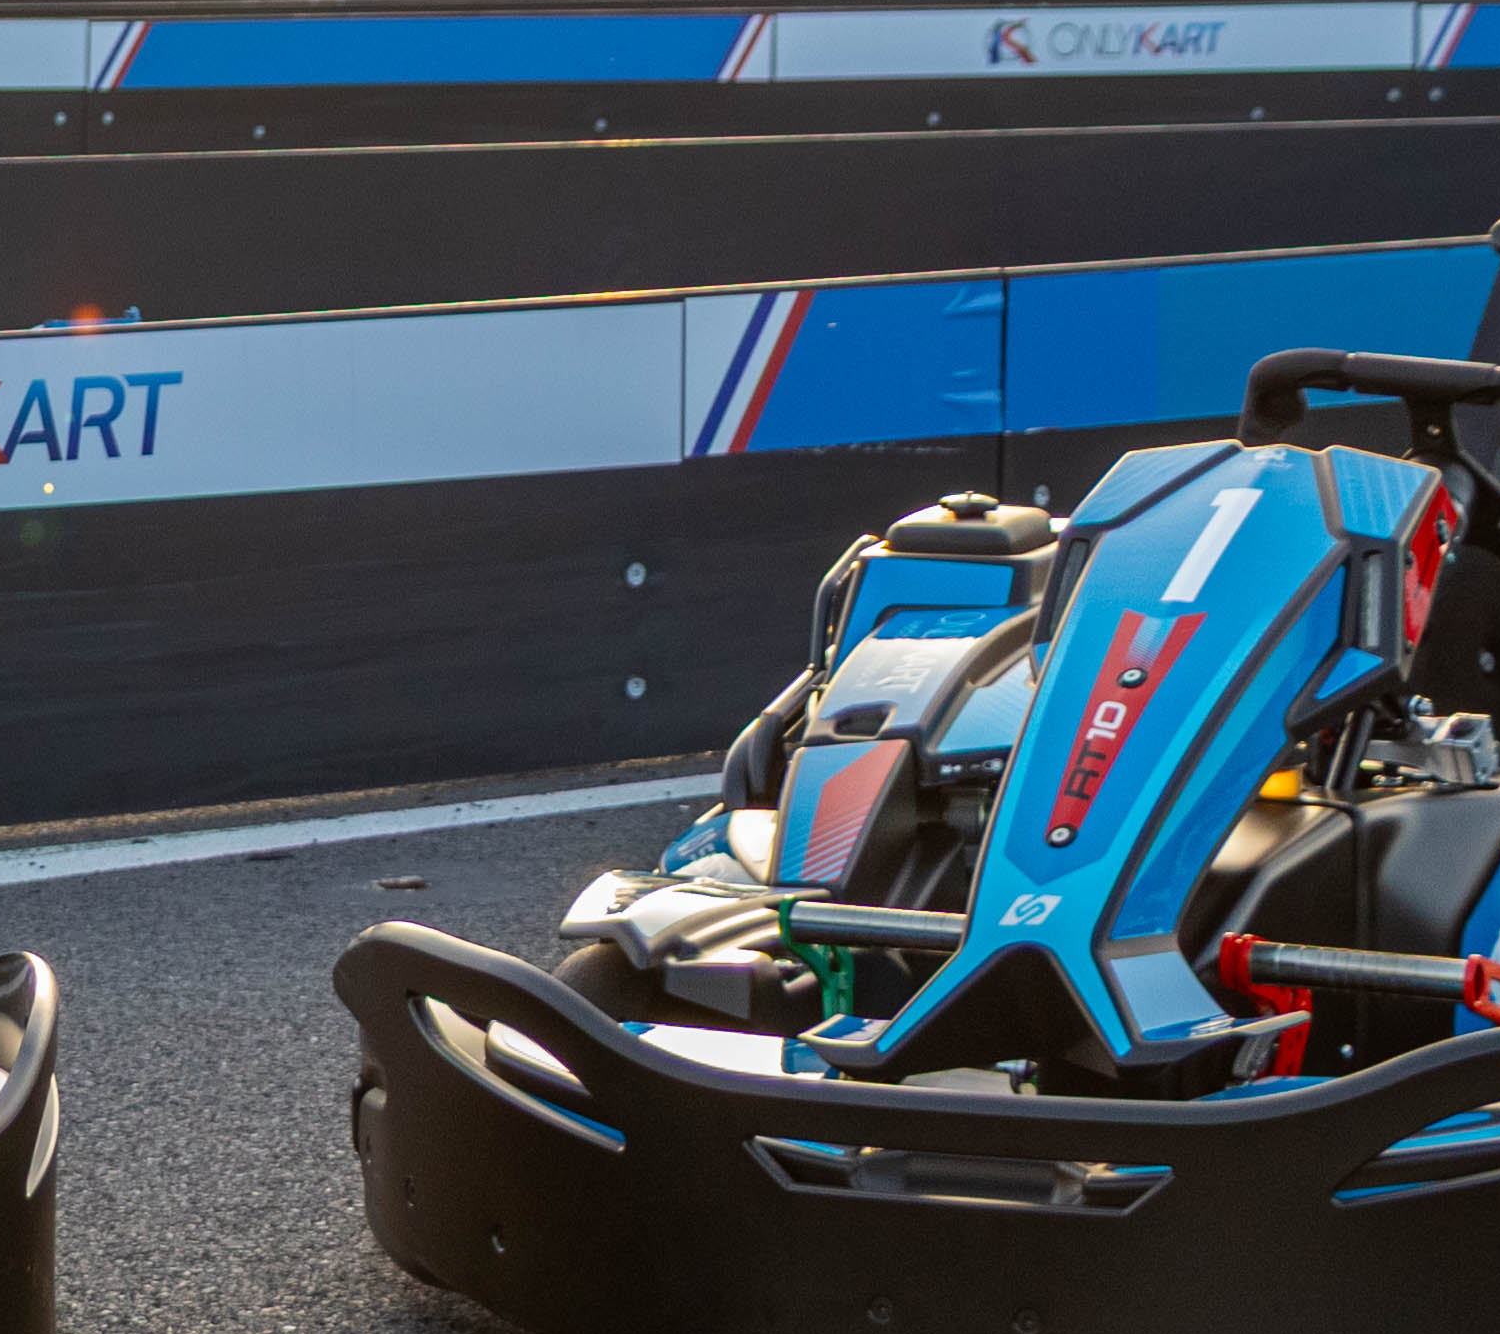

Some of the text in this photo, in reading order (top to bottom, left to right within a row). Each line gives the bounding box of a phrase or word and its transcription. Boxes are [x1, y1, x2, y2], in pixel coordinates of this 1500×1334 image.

[1046, 21, 1226, 57] ONLYKART
[1160, 487, 1264, 603] 1
[1063, 700, 1128, 801] RT10
